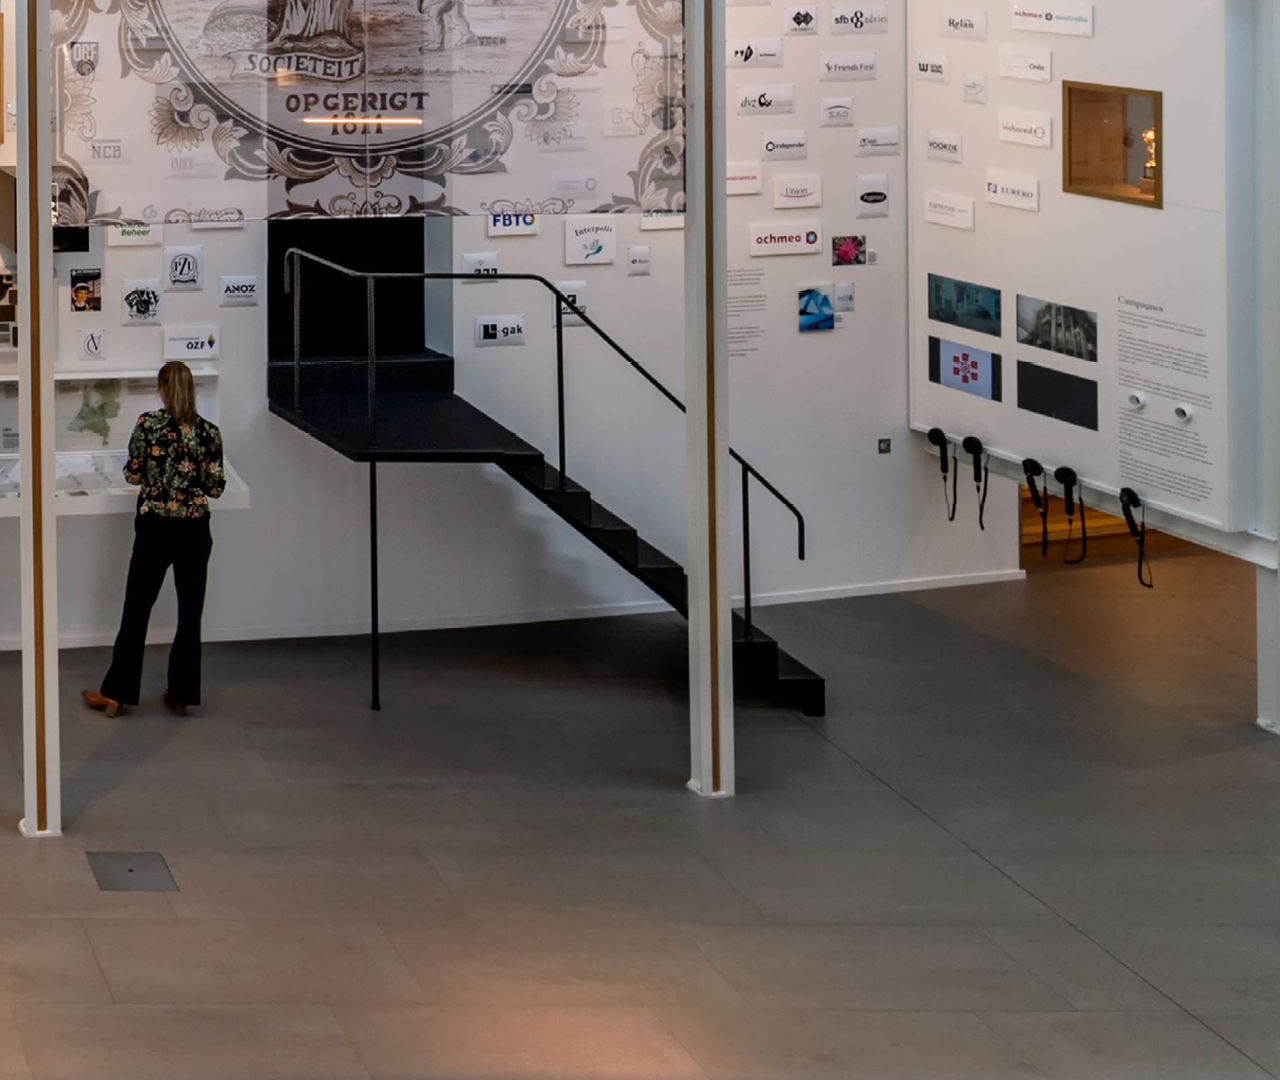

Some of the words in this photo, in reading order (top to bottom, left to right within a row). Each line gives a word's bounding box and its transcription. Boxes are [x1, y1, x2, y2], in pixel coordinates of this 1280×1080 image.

[834, 15, 850, 25] sfb
[243, 53, 361, 78] SOCIETEIT
[834, 63, 859, 72] Friends
[859, 63, 874, 71] First
[285, 91, 430, 113] OPGERIGT
[91, 145, 122, 159] NCB
[785, 186, 808, 195] Union
[492, 212, 535, 227] FBTO
[121, 228, 151, 237] Beheer
[575, 225, 613, 237] Interpolis
[1118, 295, 1164, 312] Campagnes
[502, 324, 523, 337] gak
[186, 341, 206, 350] OZF
